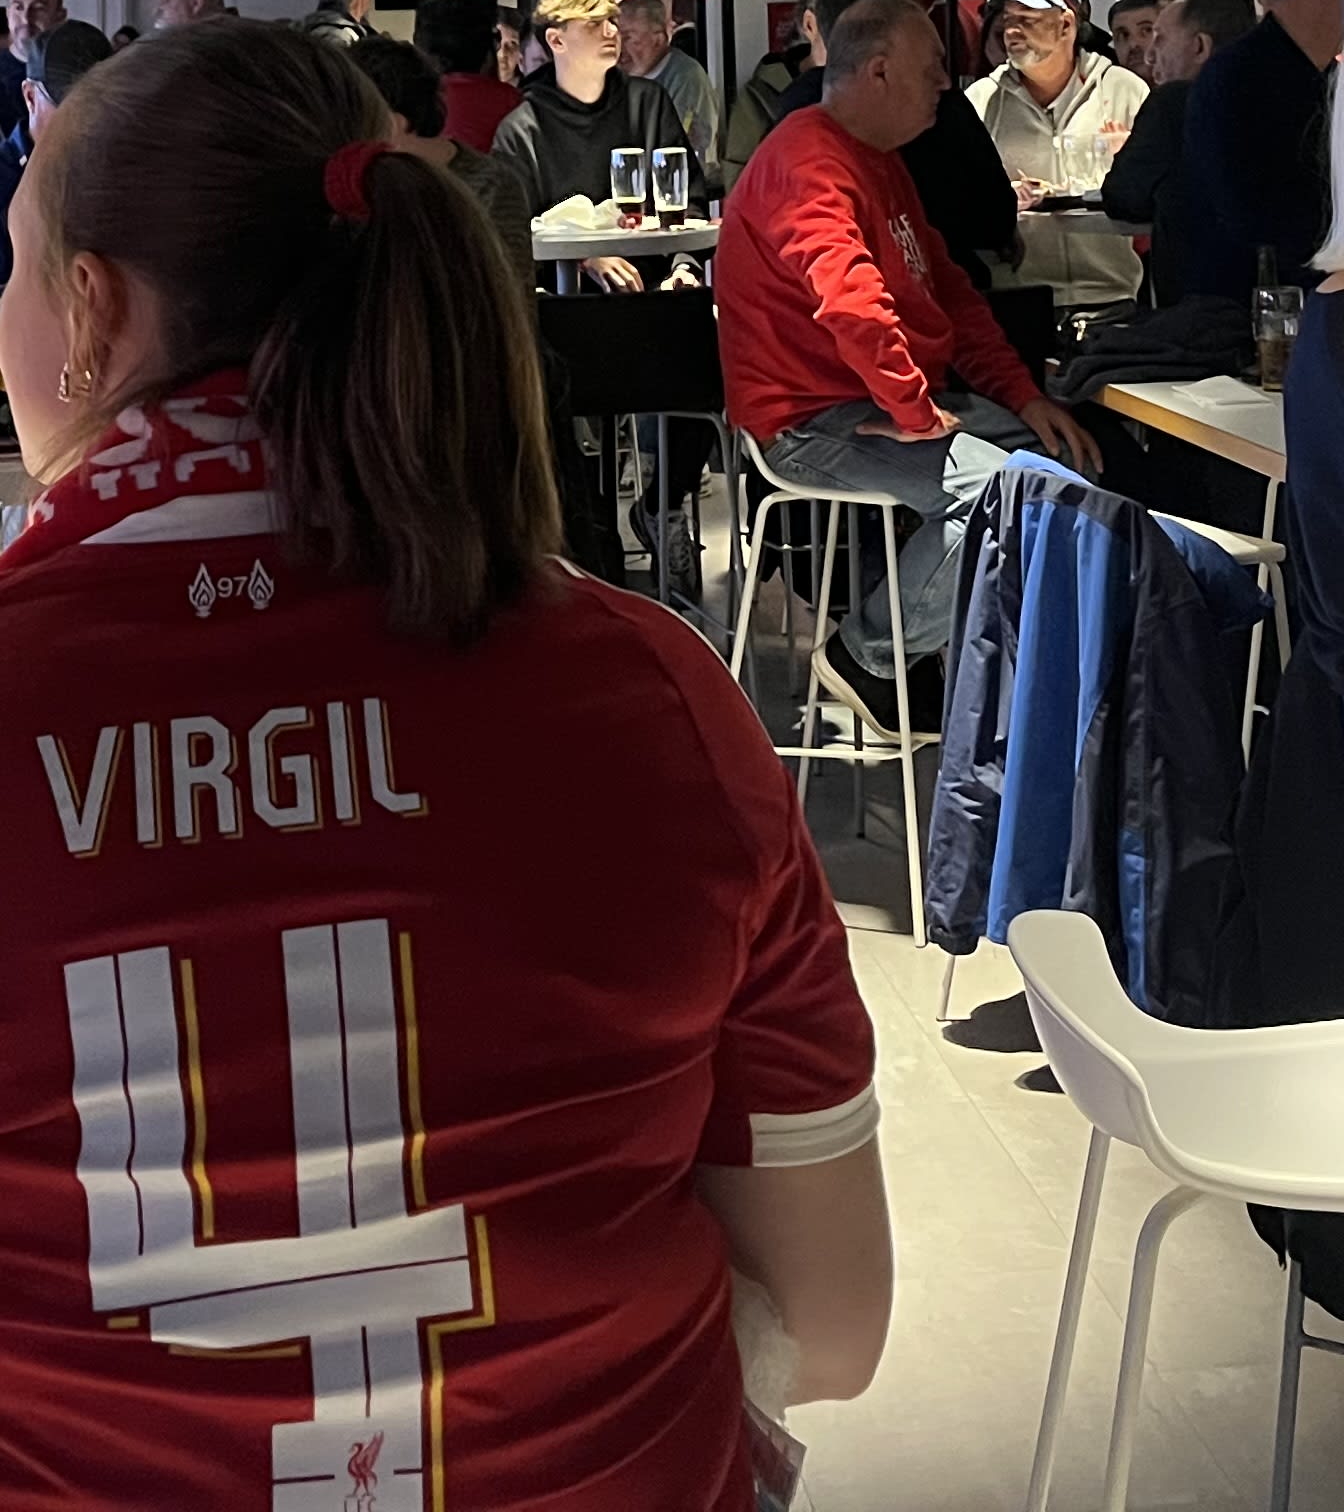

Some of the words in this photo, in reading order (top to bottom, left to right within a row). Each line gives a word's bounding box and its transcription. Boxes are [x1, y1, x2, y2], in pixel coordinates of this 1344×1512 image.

[216, 575, 249, 598] 97
[36, 696, 429, 859] VIRGIL
[63, 918, 496, 1512] 4
